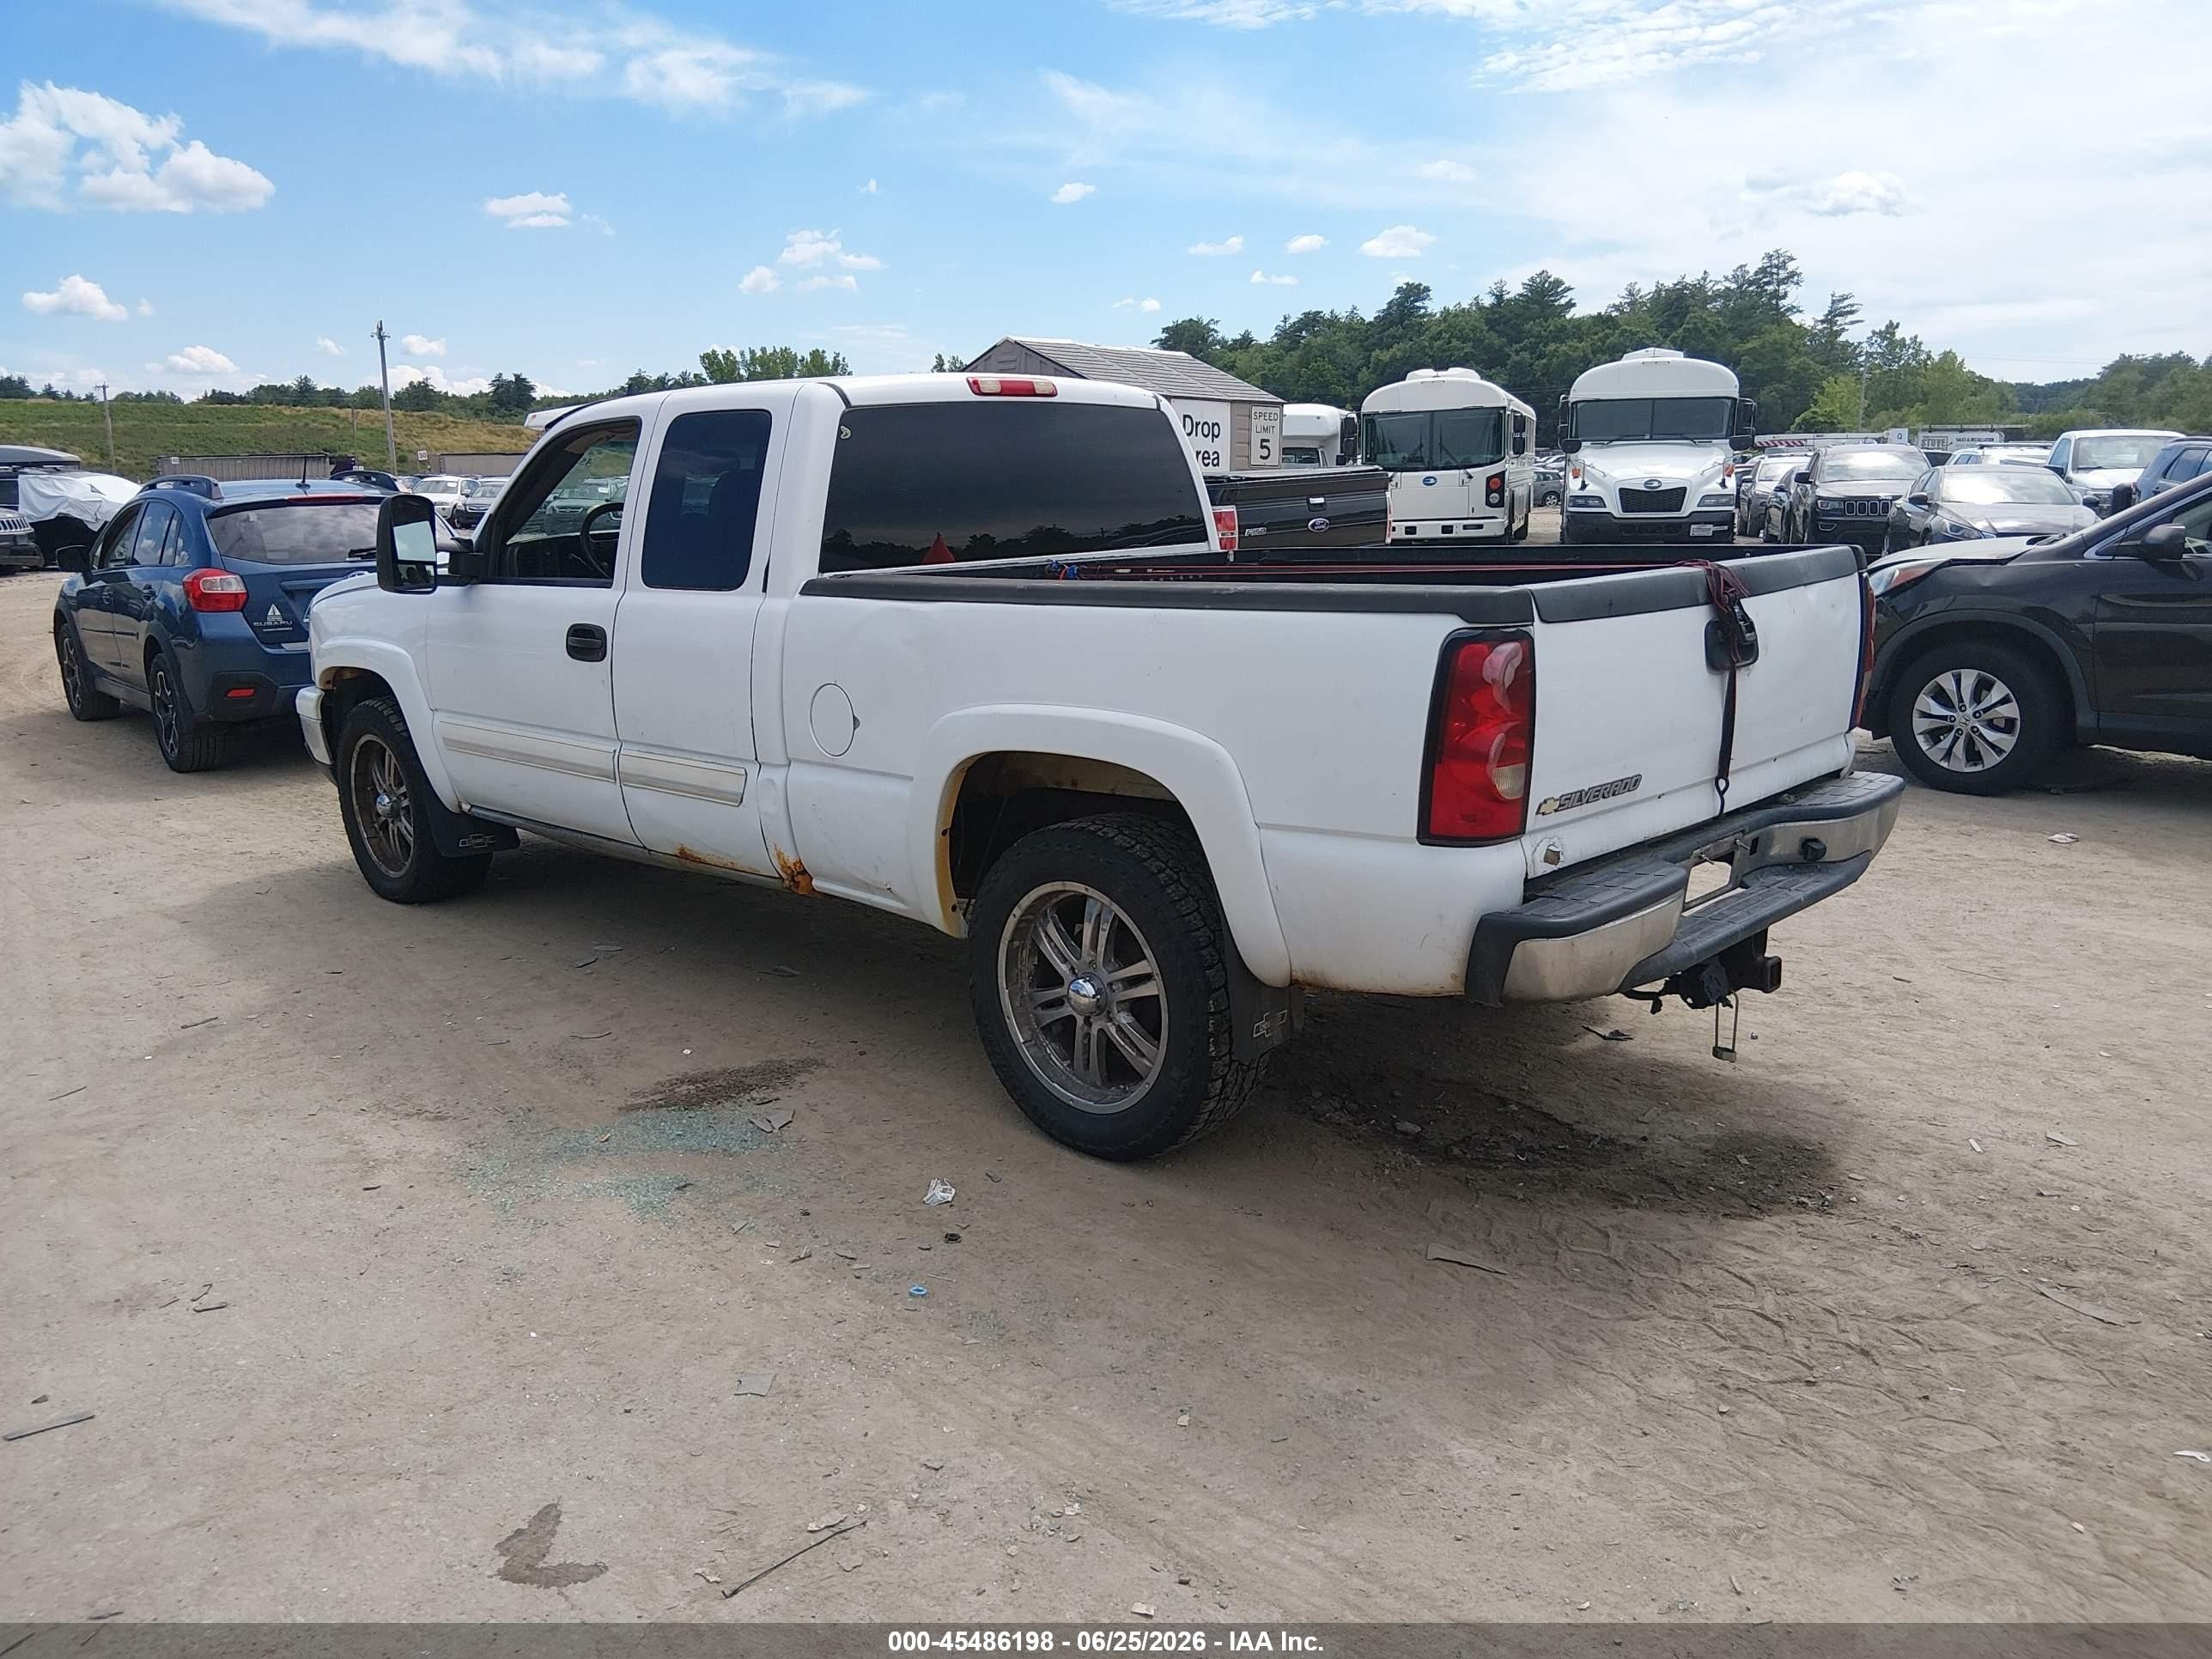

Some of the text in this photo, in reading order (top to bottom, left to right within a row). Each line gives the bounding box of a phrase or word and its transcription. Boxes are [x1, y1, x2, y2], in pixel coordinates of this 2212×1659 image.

[1253, 411, 1279, 421] SPEED
[1182, 414, 1220, 443] Drop
[1255, 426, 1276, 434] LIMIT
[1196, 448, 1220, 468] rea
[1259, 438, 1271, 460] 5
[1554, 774, 1643, 813] SILVERADO
